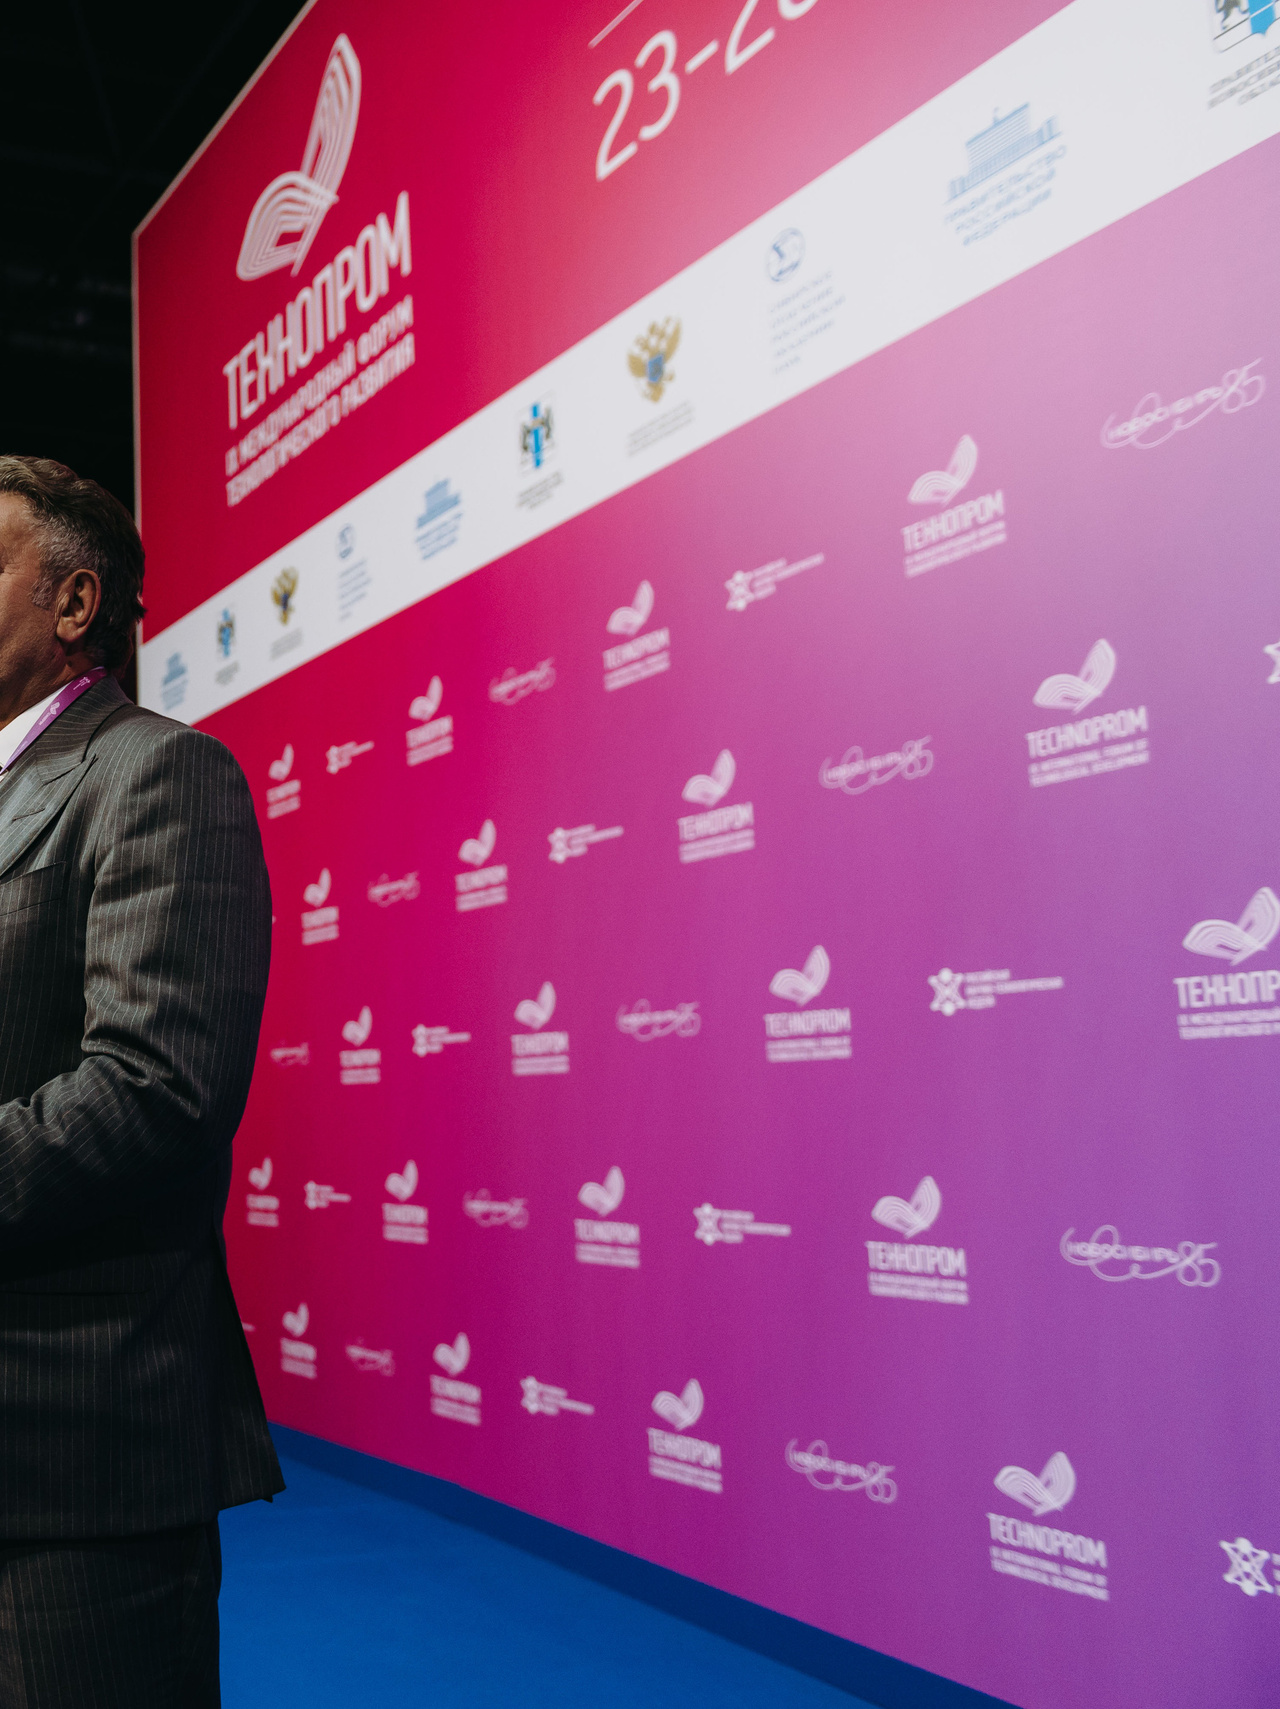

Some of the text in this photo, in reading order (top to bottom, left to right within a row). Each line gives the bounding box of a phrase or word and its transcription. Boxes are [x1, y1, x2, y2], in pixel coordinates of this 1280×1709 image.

[592, 0, 819, 182] 23-2
[223, 190, 412, 430] ТЕХНОПРОМ
[901, 490, 1004, 553] ТЕХНОПРОМ
[1026, 705, 1148, 758] TECHNOPROM
[865, 1239, 968, 1277] ТЕХНОПРОМ
[986, 1511, 1108, 1570] TECHNOPROM
